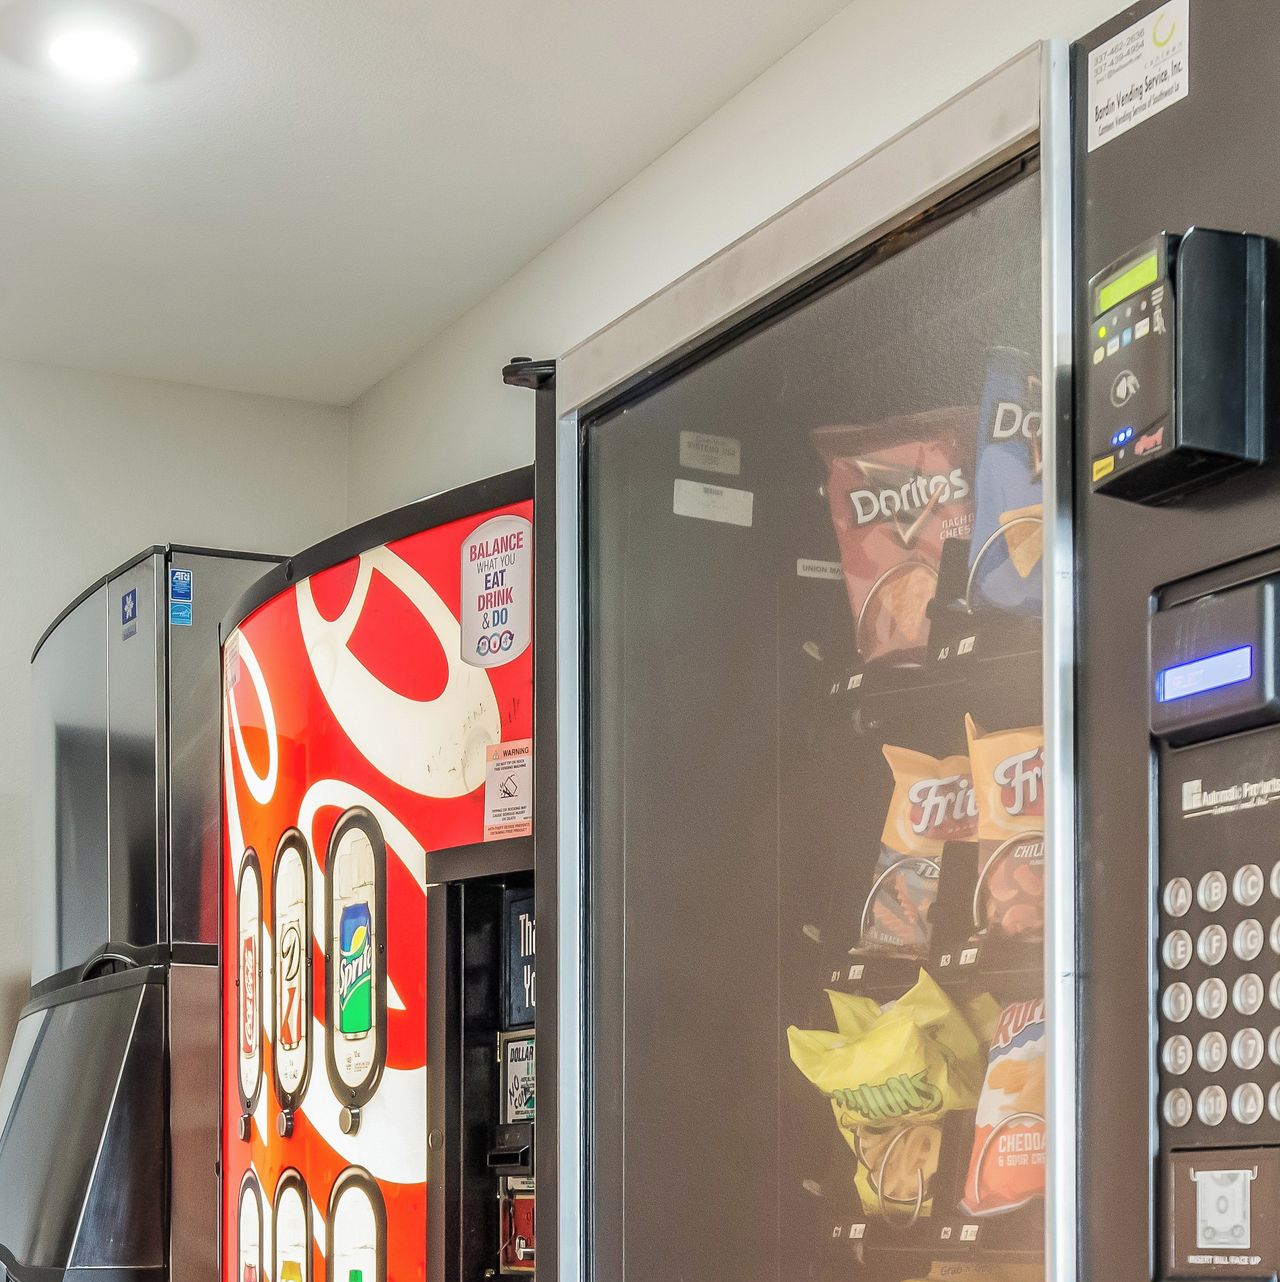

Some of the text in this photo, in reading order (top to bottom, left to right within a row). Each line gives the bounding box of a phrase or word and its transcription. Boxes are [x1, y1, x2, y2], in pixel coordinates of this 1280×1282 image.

[849, 467, 970, 525] Doritos
[469, 531, 524, 562] BALANCE
[476, 553, 516, 574] WHAT YOU
[801, 564, 828, 574] UNION
[477, 586, 514, 612] DRINK
[482, 607, 508, 630] & DO
[502, 747, 530, 758] WARNING
[993, 747, 1045, 816] Fr
